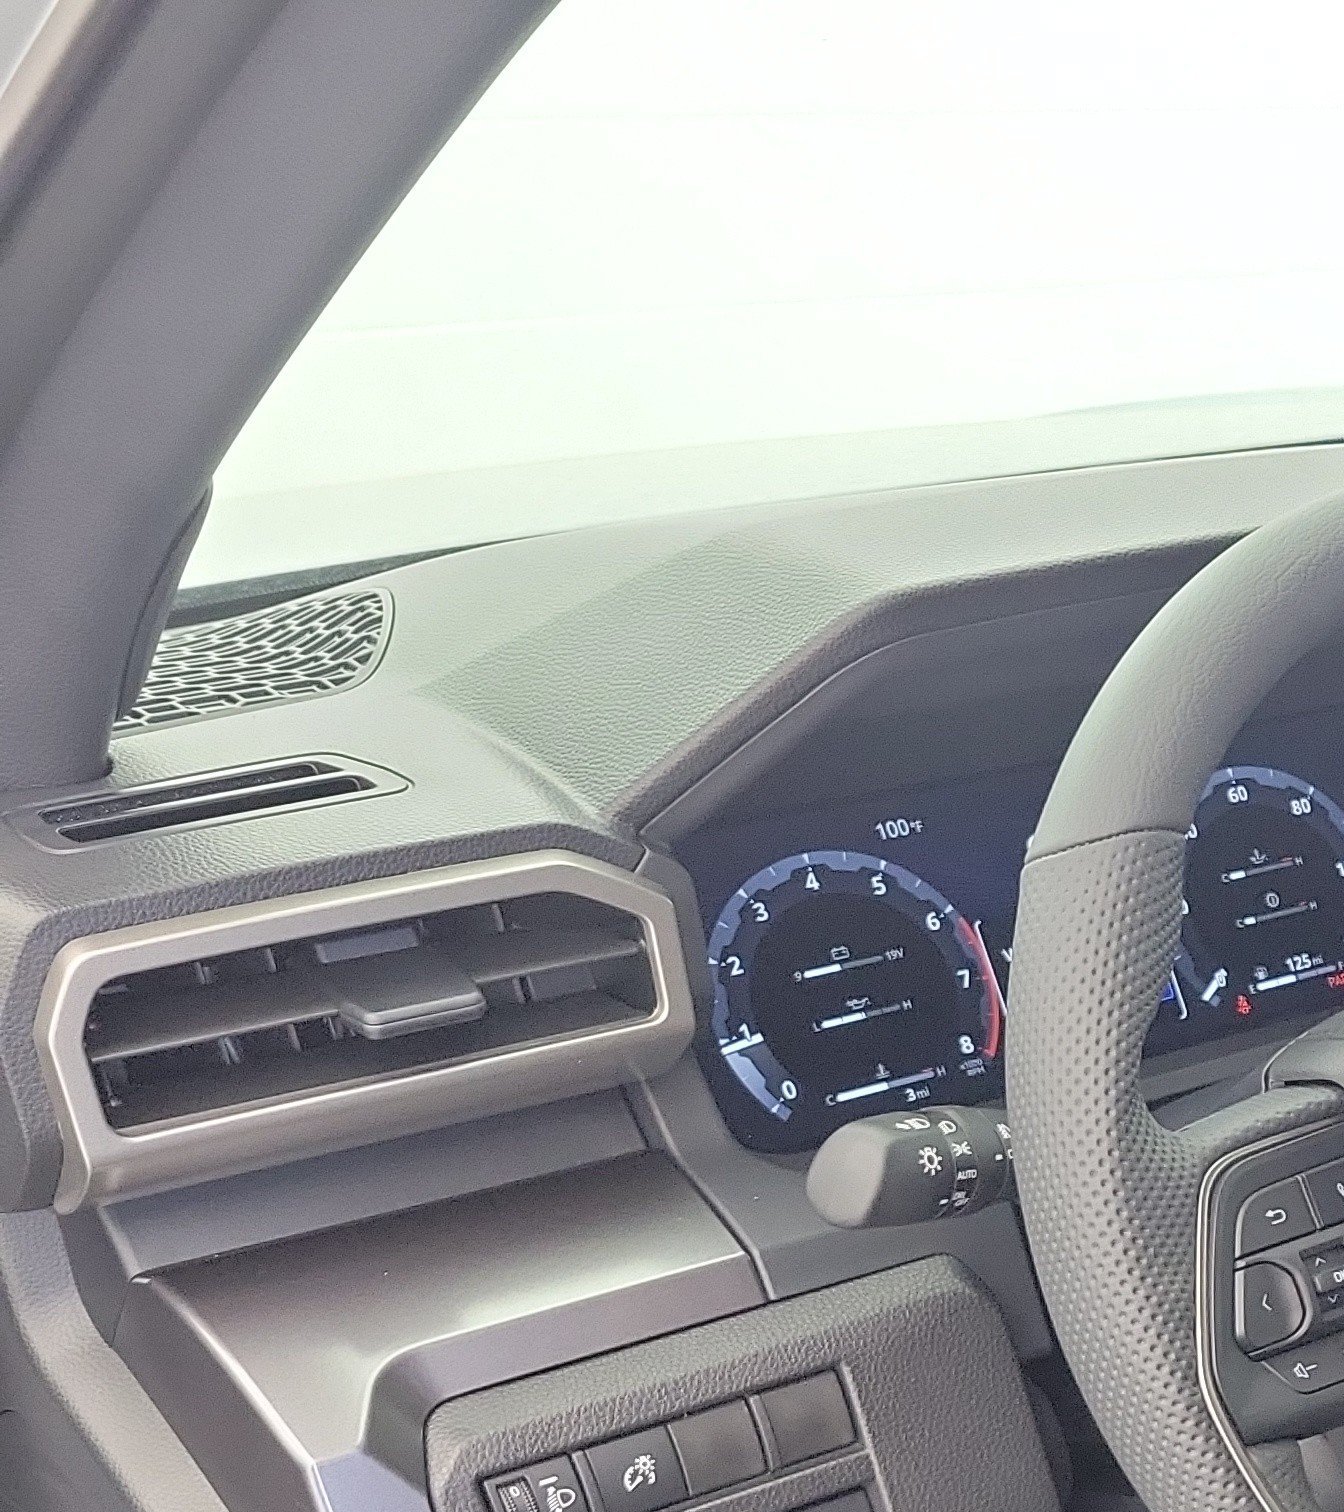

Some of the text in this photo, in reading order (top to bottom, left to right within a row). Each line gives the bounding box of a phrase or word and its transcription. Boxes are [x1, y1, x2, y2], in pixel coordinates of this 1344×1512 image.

[1226, 785, 1249, 803] 60
[1290, 798, 1312, 816] 80
[805, 871, 821, 891] 4
[871, 876, 887, 897] 5
[752, 902, 770, 922] 3
[925, 911, 941, 931] 6
[726, 955, 745, 977] 2
[957, 969, 971, 989] 7
[958, 1035, 975, 1055] 8
[780, 1079, 799, 1101] 0
[956, 1168, 978, 1180] AUTO
